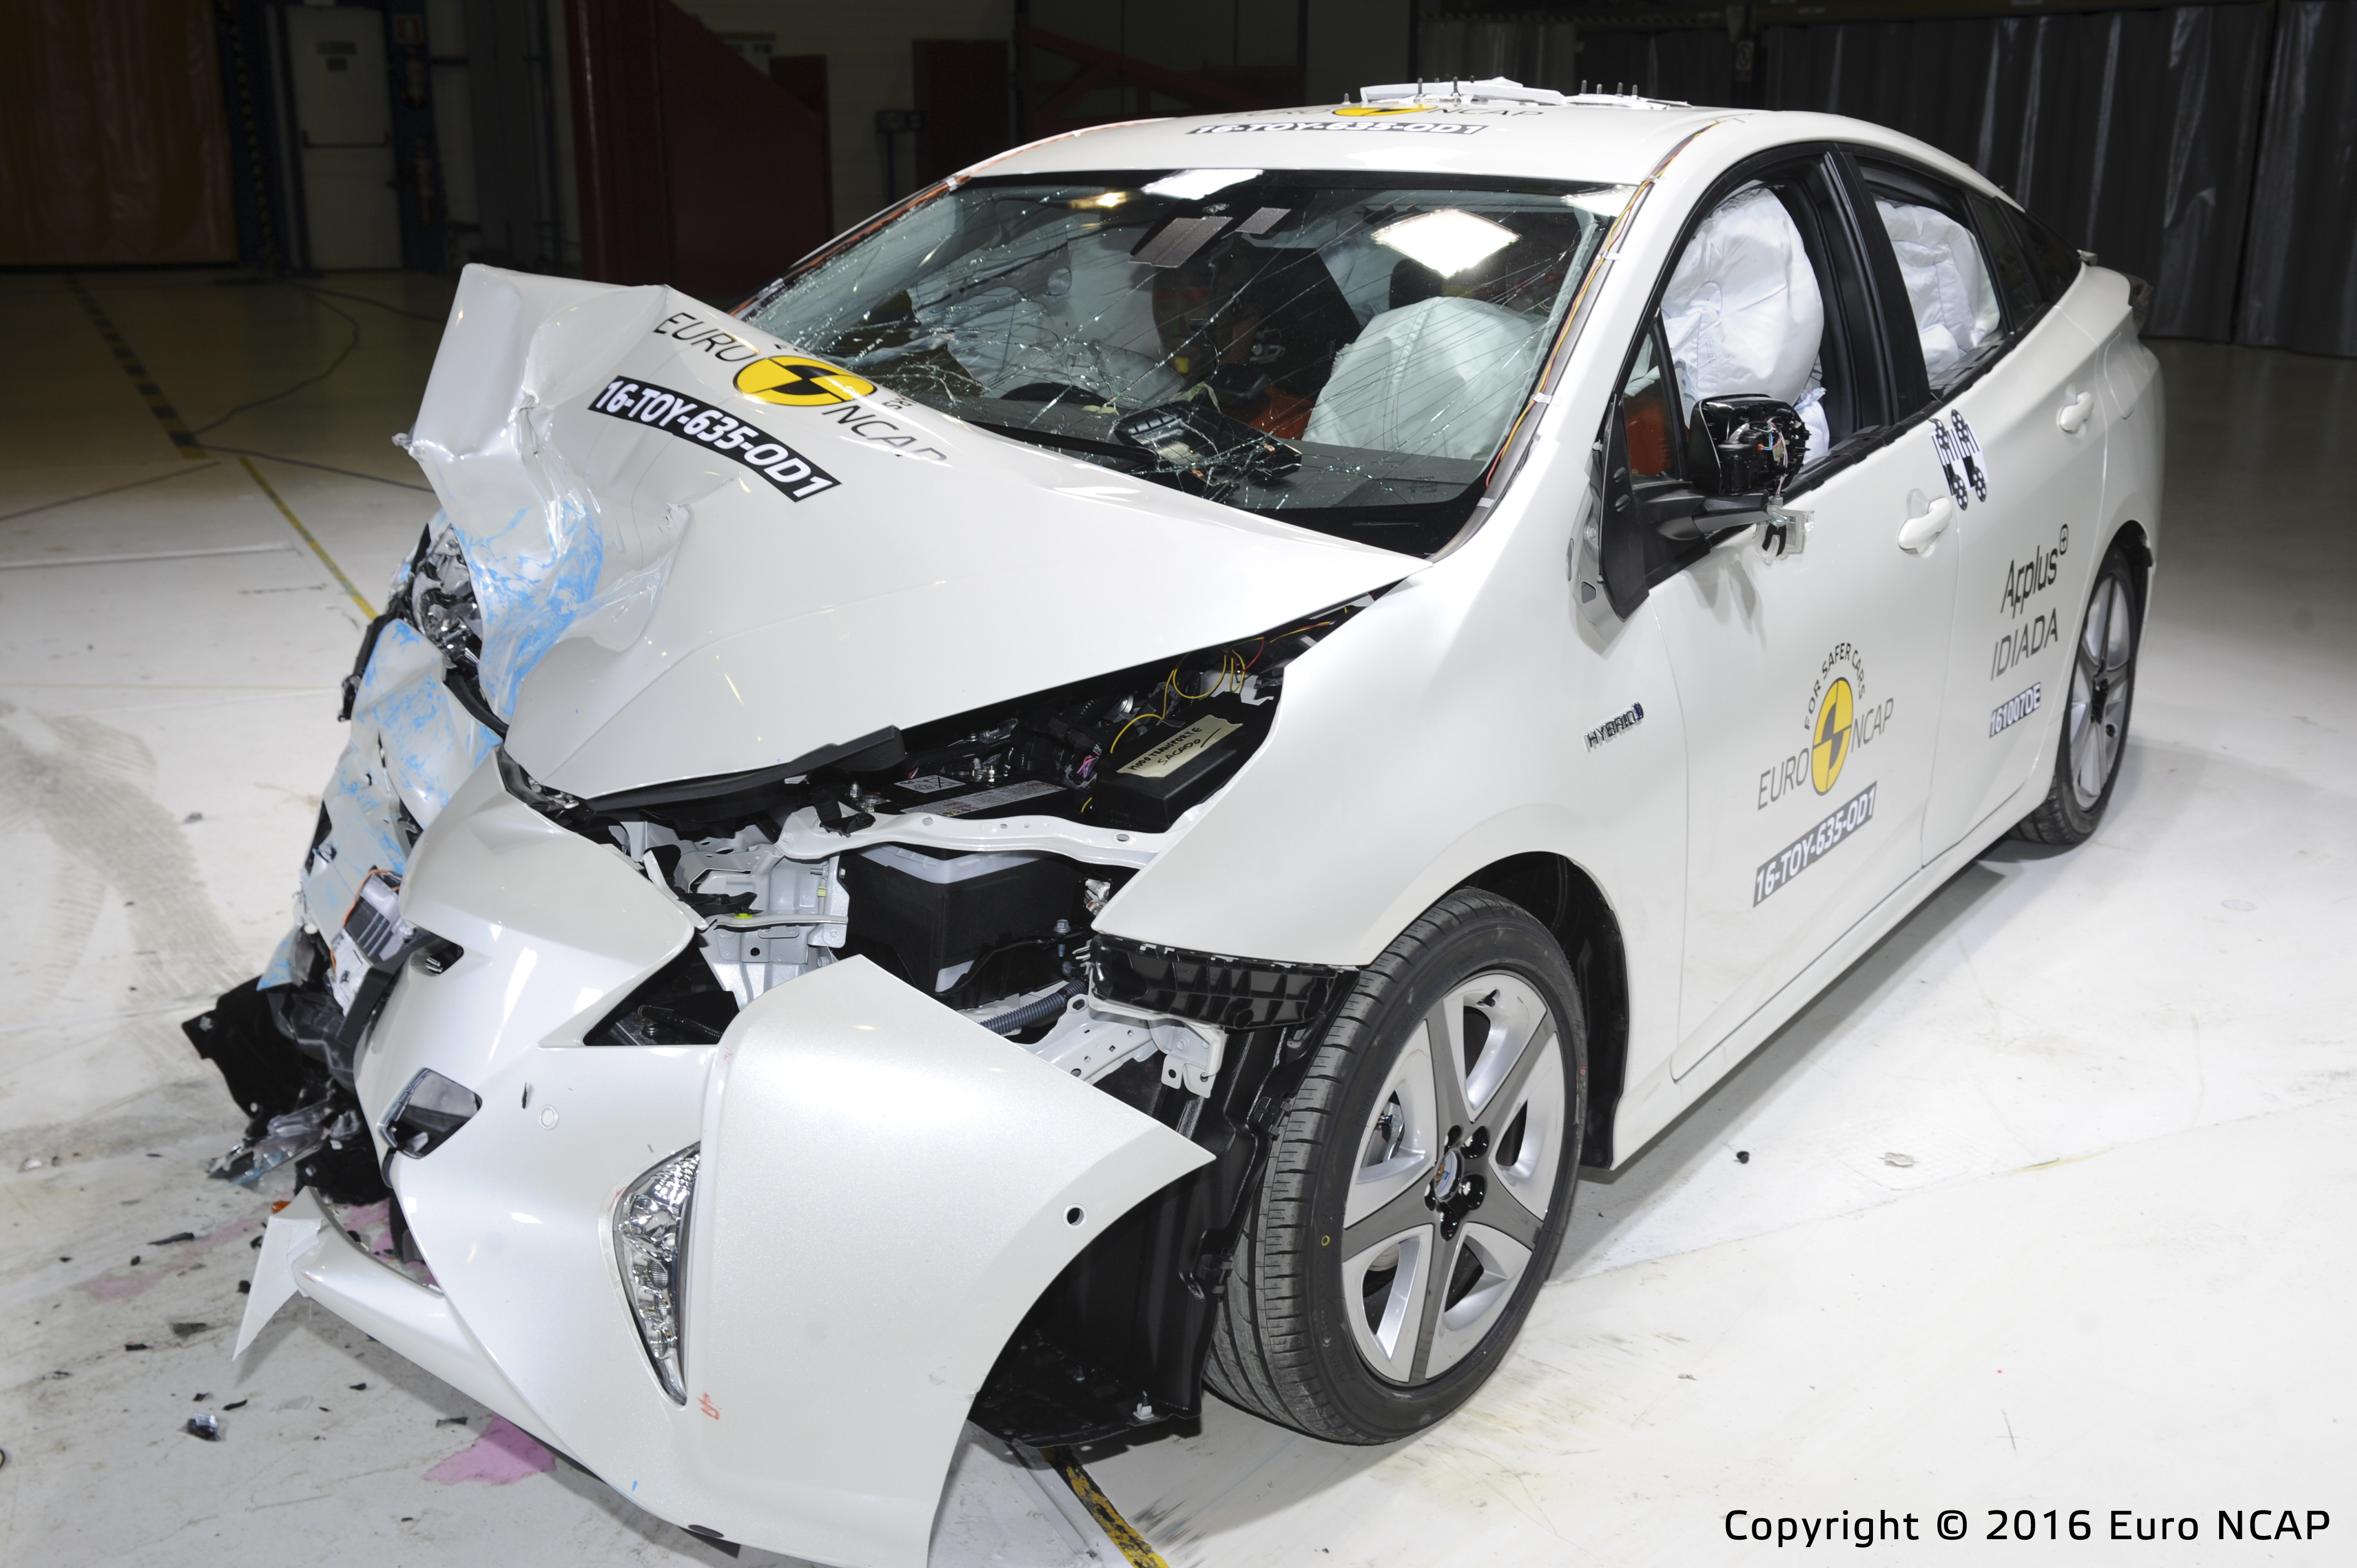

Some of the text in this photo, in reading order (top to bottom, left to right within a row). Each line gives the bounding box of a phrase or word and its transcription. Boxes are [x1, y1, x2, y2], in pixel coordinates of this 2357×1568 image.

[653, 312, 948, 461] EURO NCAP
[595, 380, 832, 498] 16-TOY-635-OD1
[1991, 608, 2058, 682] IDIADA
[1804, 642, 1866, 730] FOR SAFER CARS
[1990, 684, 2041, 737] 161007DE
[1149, 727, 1202, 757] TRANSPORTE
[1157, 739, 1201, 766] SACADO
[1583, 710, 1637, 752] HYBRID
[1758, 698, 1894, 811] EURO NCAP
[1757, 786, 1875, 901] 16-TOY-635-OD1
